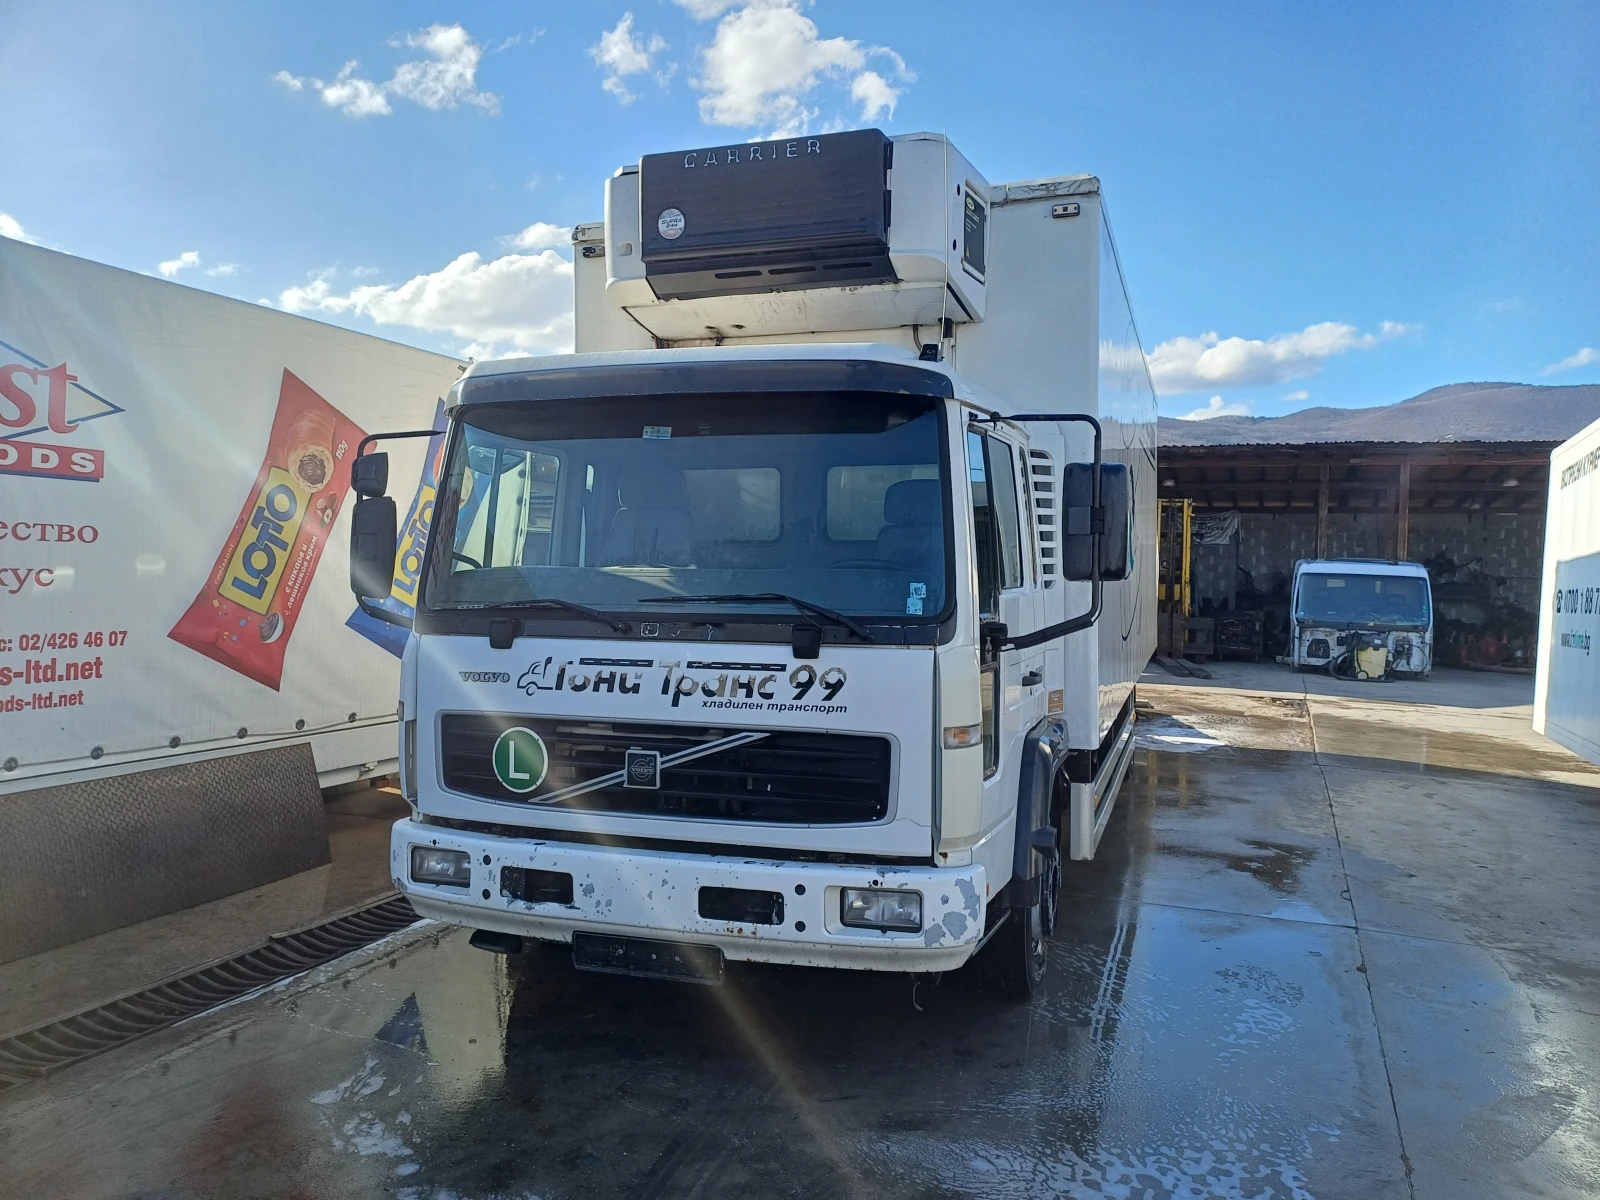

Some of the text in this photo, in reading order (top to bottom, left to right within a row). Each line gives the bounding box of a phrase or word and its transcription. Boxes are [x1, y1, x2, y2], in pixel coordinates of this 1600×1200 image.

[684, 139, 820, 168] CARRIER
[231, 484, 297, 600] LOTTO
[301, 543, 308, 551] и
[305, 535, 318, 561] крем
[214, 543, 235, 585] croissant
[1584, 587, 1594, 615] 88
[19, 632, 78, 653] 02/426
[83, 631, 104, 648] 46
[108, 630, 128, 647] 07
[0, 656, 103, 686] s-ltd.net
[459, 671, 511, 683] VOLVO
[659, 660, 777, 707] Транс
[789, 664, 847, 702] 99
[701, 699, 848, 714] хладилен транспорт
[509, 740, 530, 780] L
